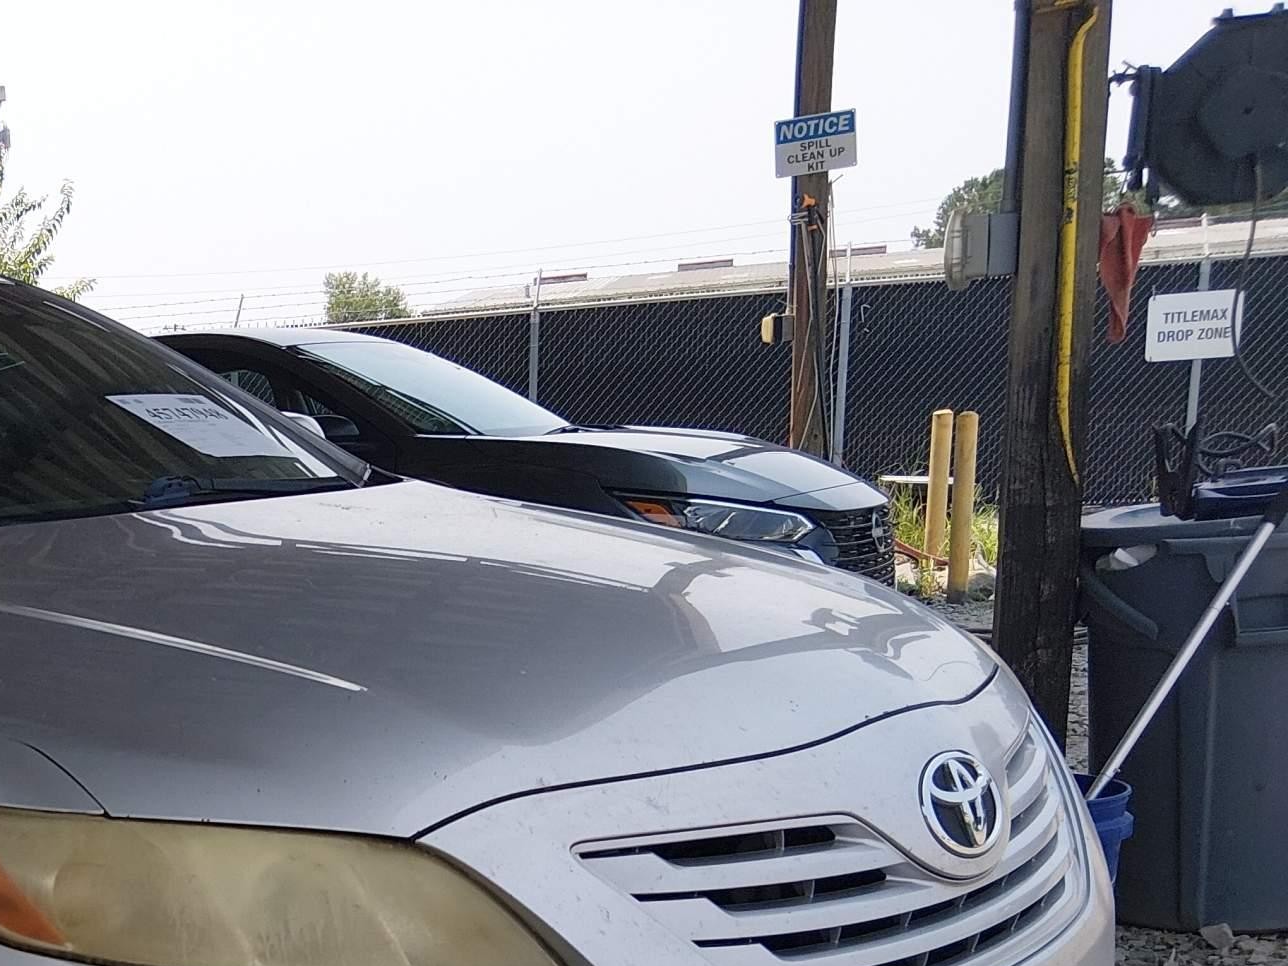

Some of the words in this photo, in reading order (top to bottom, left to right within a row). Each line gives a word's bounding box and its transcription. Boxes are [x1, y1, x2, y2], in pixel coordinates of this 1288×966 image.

[780, 114, 851, 141] NOTICE
[800, 139, 831, 152] SPILL
[787, 150, 824, 164] CLEAN
[829, 147, 845, 158] UP
[808, 161, 825, 172] KIT
[1163, 308, 1228, 324] TITLEMAX
[1157, 329, 1193, 343] DROP
[1197, 326, 1232, 340] ZONE
[145, 407, 229, 421] 45747948
